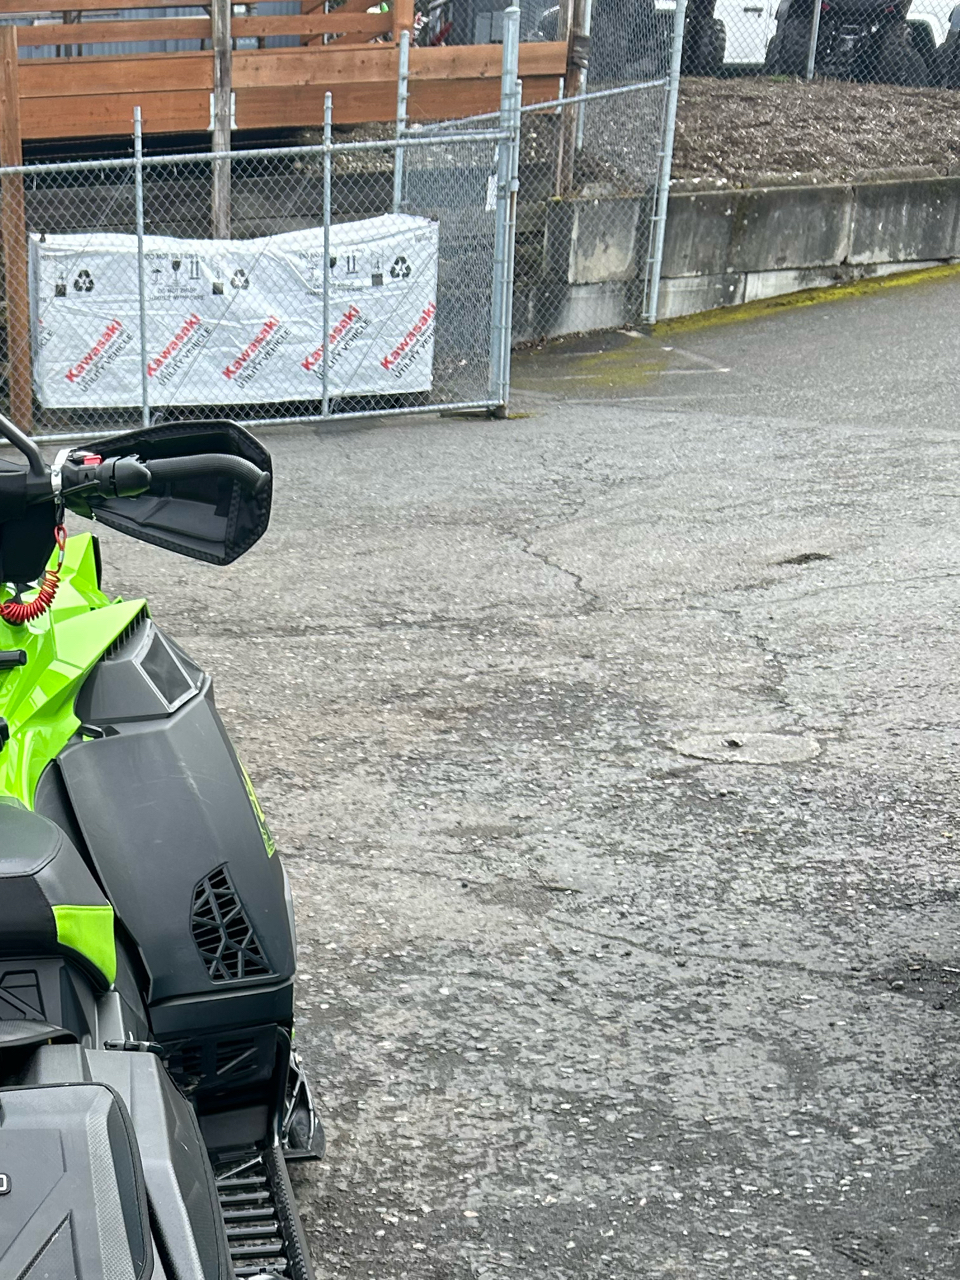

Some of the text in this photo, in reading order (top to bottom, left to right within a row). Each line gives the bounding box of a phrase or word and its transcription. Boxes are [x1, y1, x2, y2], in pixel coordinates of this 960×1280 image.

[65, 318, 123, 382] Kawasaki
[80, 332, 134, 394] UTILITY VEHICLE
[146, 313, 201, 377] Kawasaki
[159, 326, 213, 387] UTILITY VEHICLE
[222, 314, 281, 380] Kawasaki
[237, 328, 292, 390] UTILITY VEHICLE
[341, 317, 372, 352] VEHICLE
[381, 301, 437, 371] Kawasaki
[395, 348, 422, 379] UTILITY
